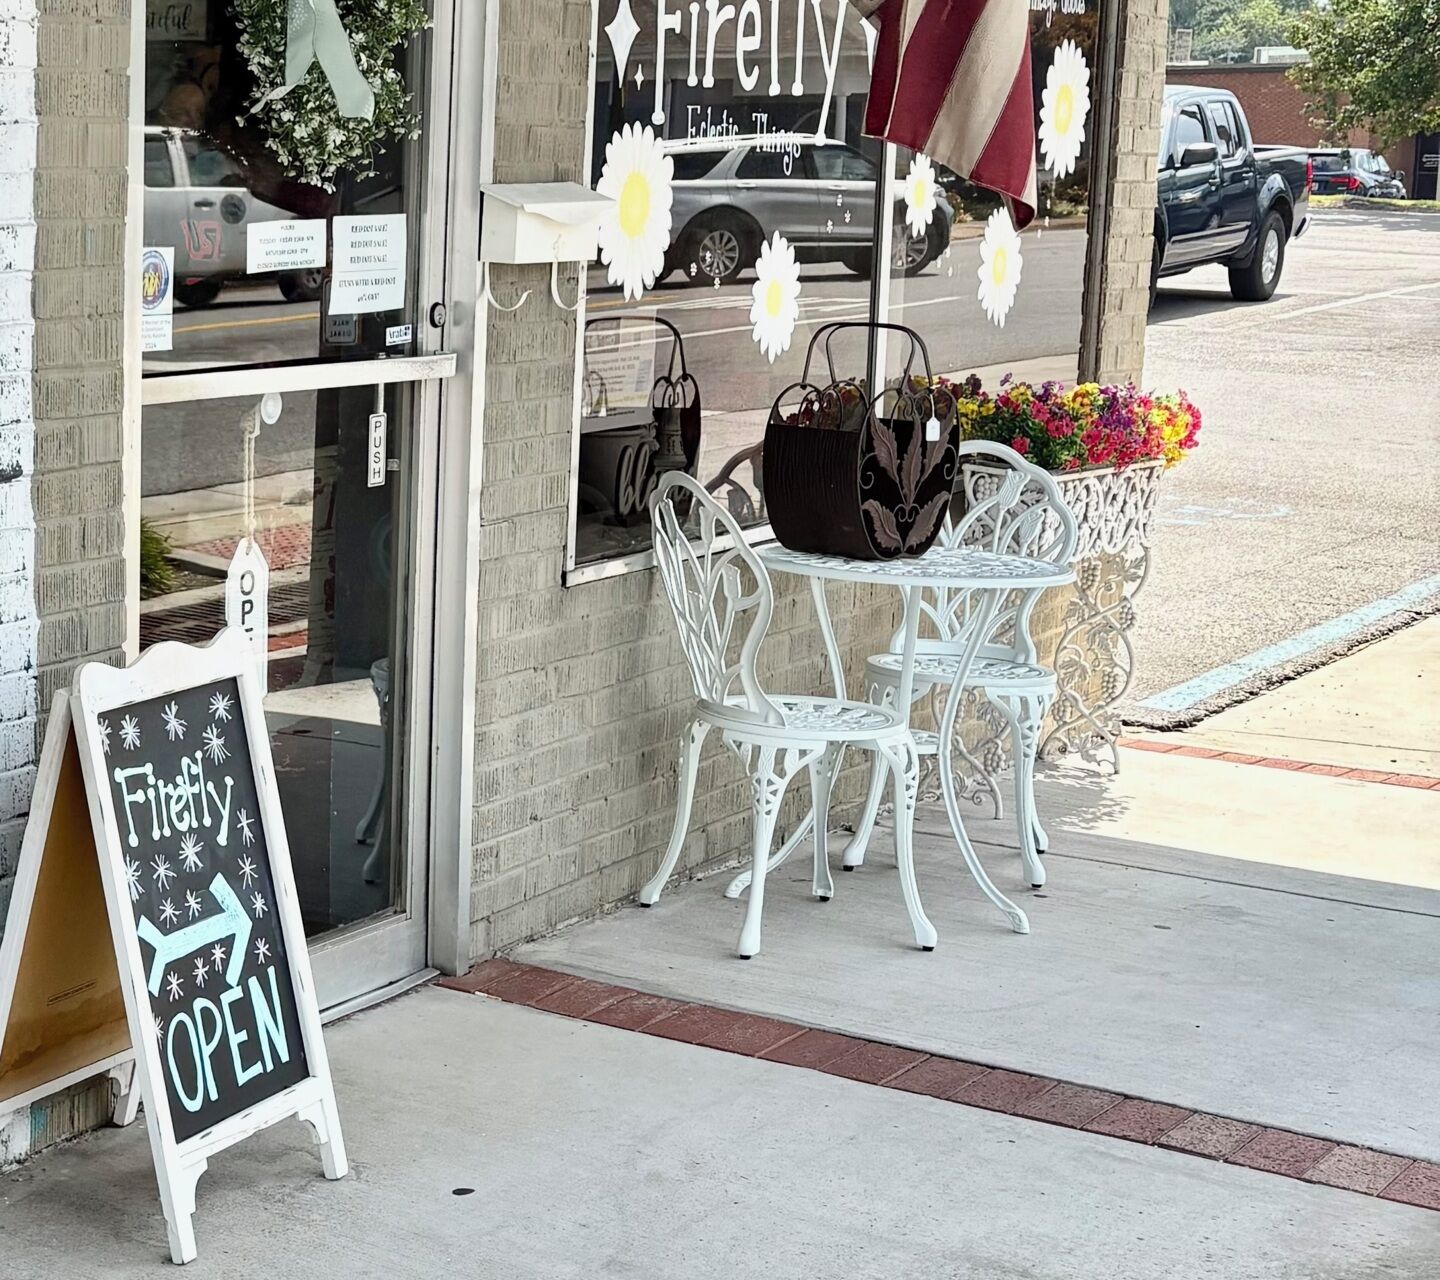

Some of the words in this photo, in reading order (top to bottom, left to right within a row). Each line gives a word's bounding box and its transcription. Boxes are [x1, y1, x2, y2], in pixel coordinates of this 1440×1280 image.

[686, 105, 739, 149] Eclectic
[752, 112, 801, 176] Things
[372, 420, 383, 480] PUSH
[240, 569, 255, 632] OP
[114, 750, 234, 848] Firefly
[167, 965, 290, 1113] OPEN
